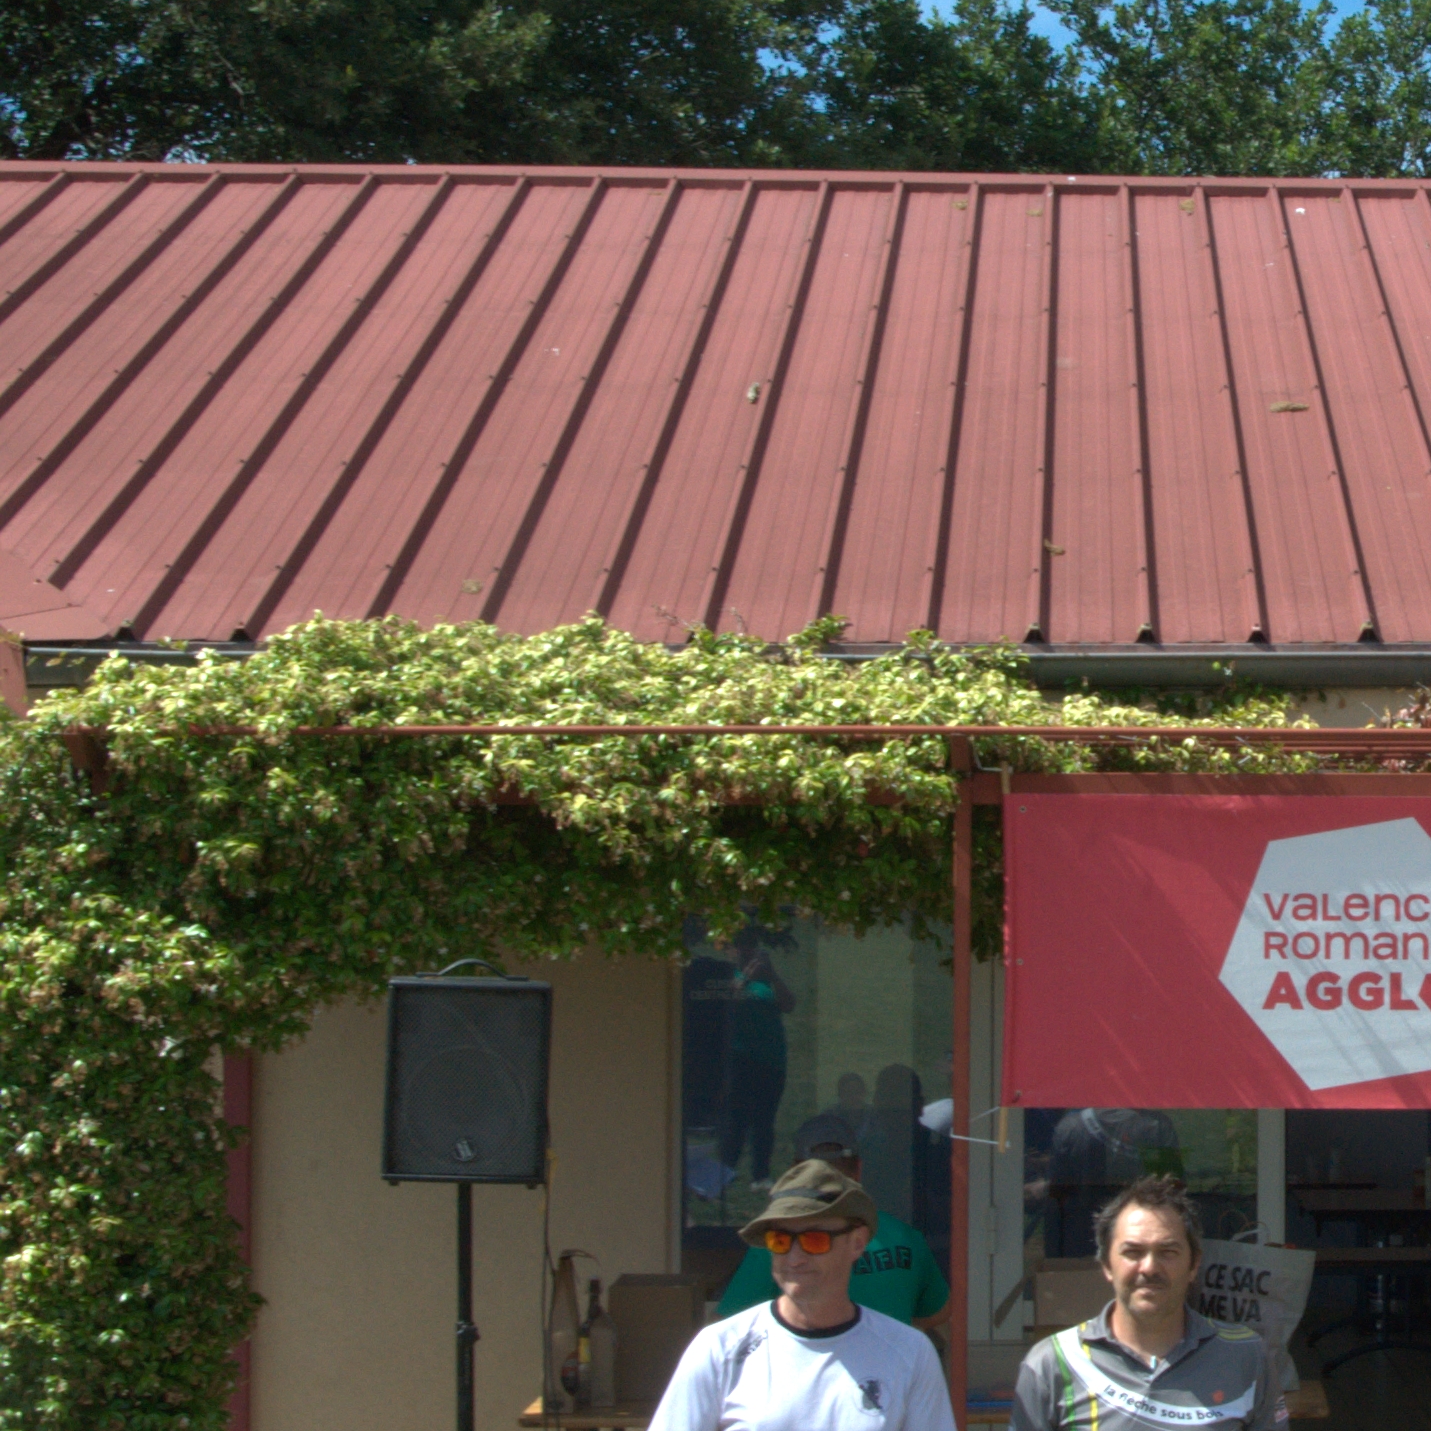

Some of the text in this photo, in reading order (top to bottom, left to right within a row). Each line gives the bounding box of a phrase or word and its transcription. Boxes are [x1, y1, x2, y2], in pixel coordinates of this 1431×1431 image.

[853, 1245, 912, 1275] AFF
[1204, 1263, 1272, 1296] CE SAC
[1199, 1292, 1262, 1322] ME VA
[1160, 1407, 1193, 1420] sous
